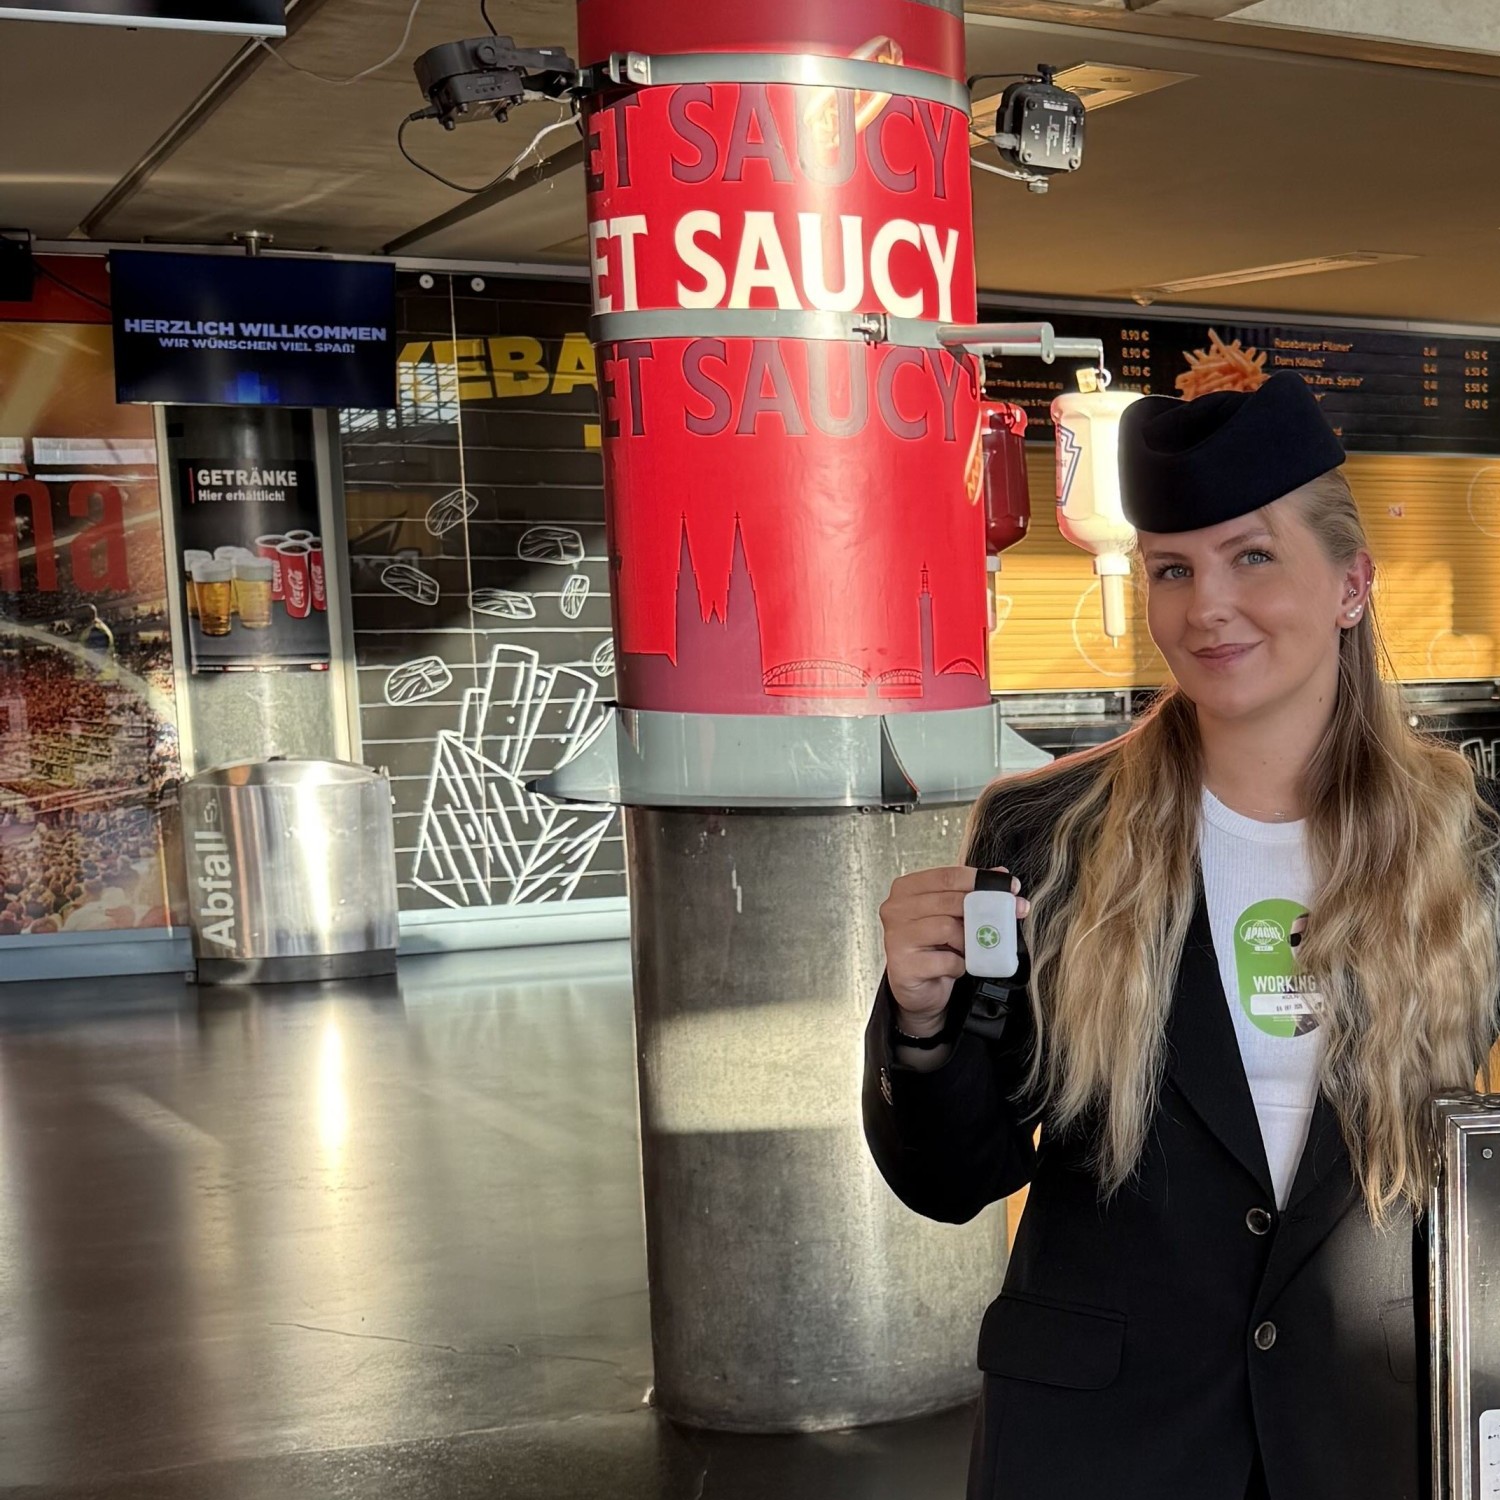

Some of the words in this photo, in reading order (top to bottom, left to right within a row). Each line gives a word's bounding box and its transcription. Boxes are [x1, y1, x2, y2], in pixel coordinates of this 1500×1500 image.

[668, 83, 954, 200] SAUCY
[589, 214, 648, 315] ET
[674, 209, 959, 323] SAUCY
[124, 318, 234, 336] HERZLICH
[240, 322, 387, 341] WILLKOMMEN
[159, 337, 189, 349] WIR
[192, 337, 277, 352] WÜNSCHEN
[280, 341, 311, 352] VIEL
[682, 337, 966, 442] SAUCY
[197, 467, 298, 487] GETRÄNKE
[198, 489, 223, 501] Hier
[226, 489, 285, 502] erhältlich!
[194, 831, 237, 949] Abfall
[1253, 974, 1316, 993] WORKING
